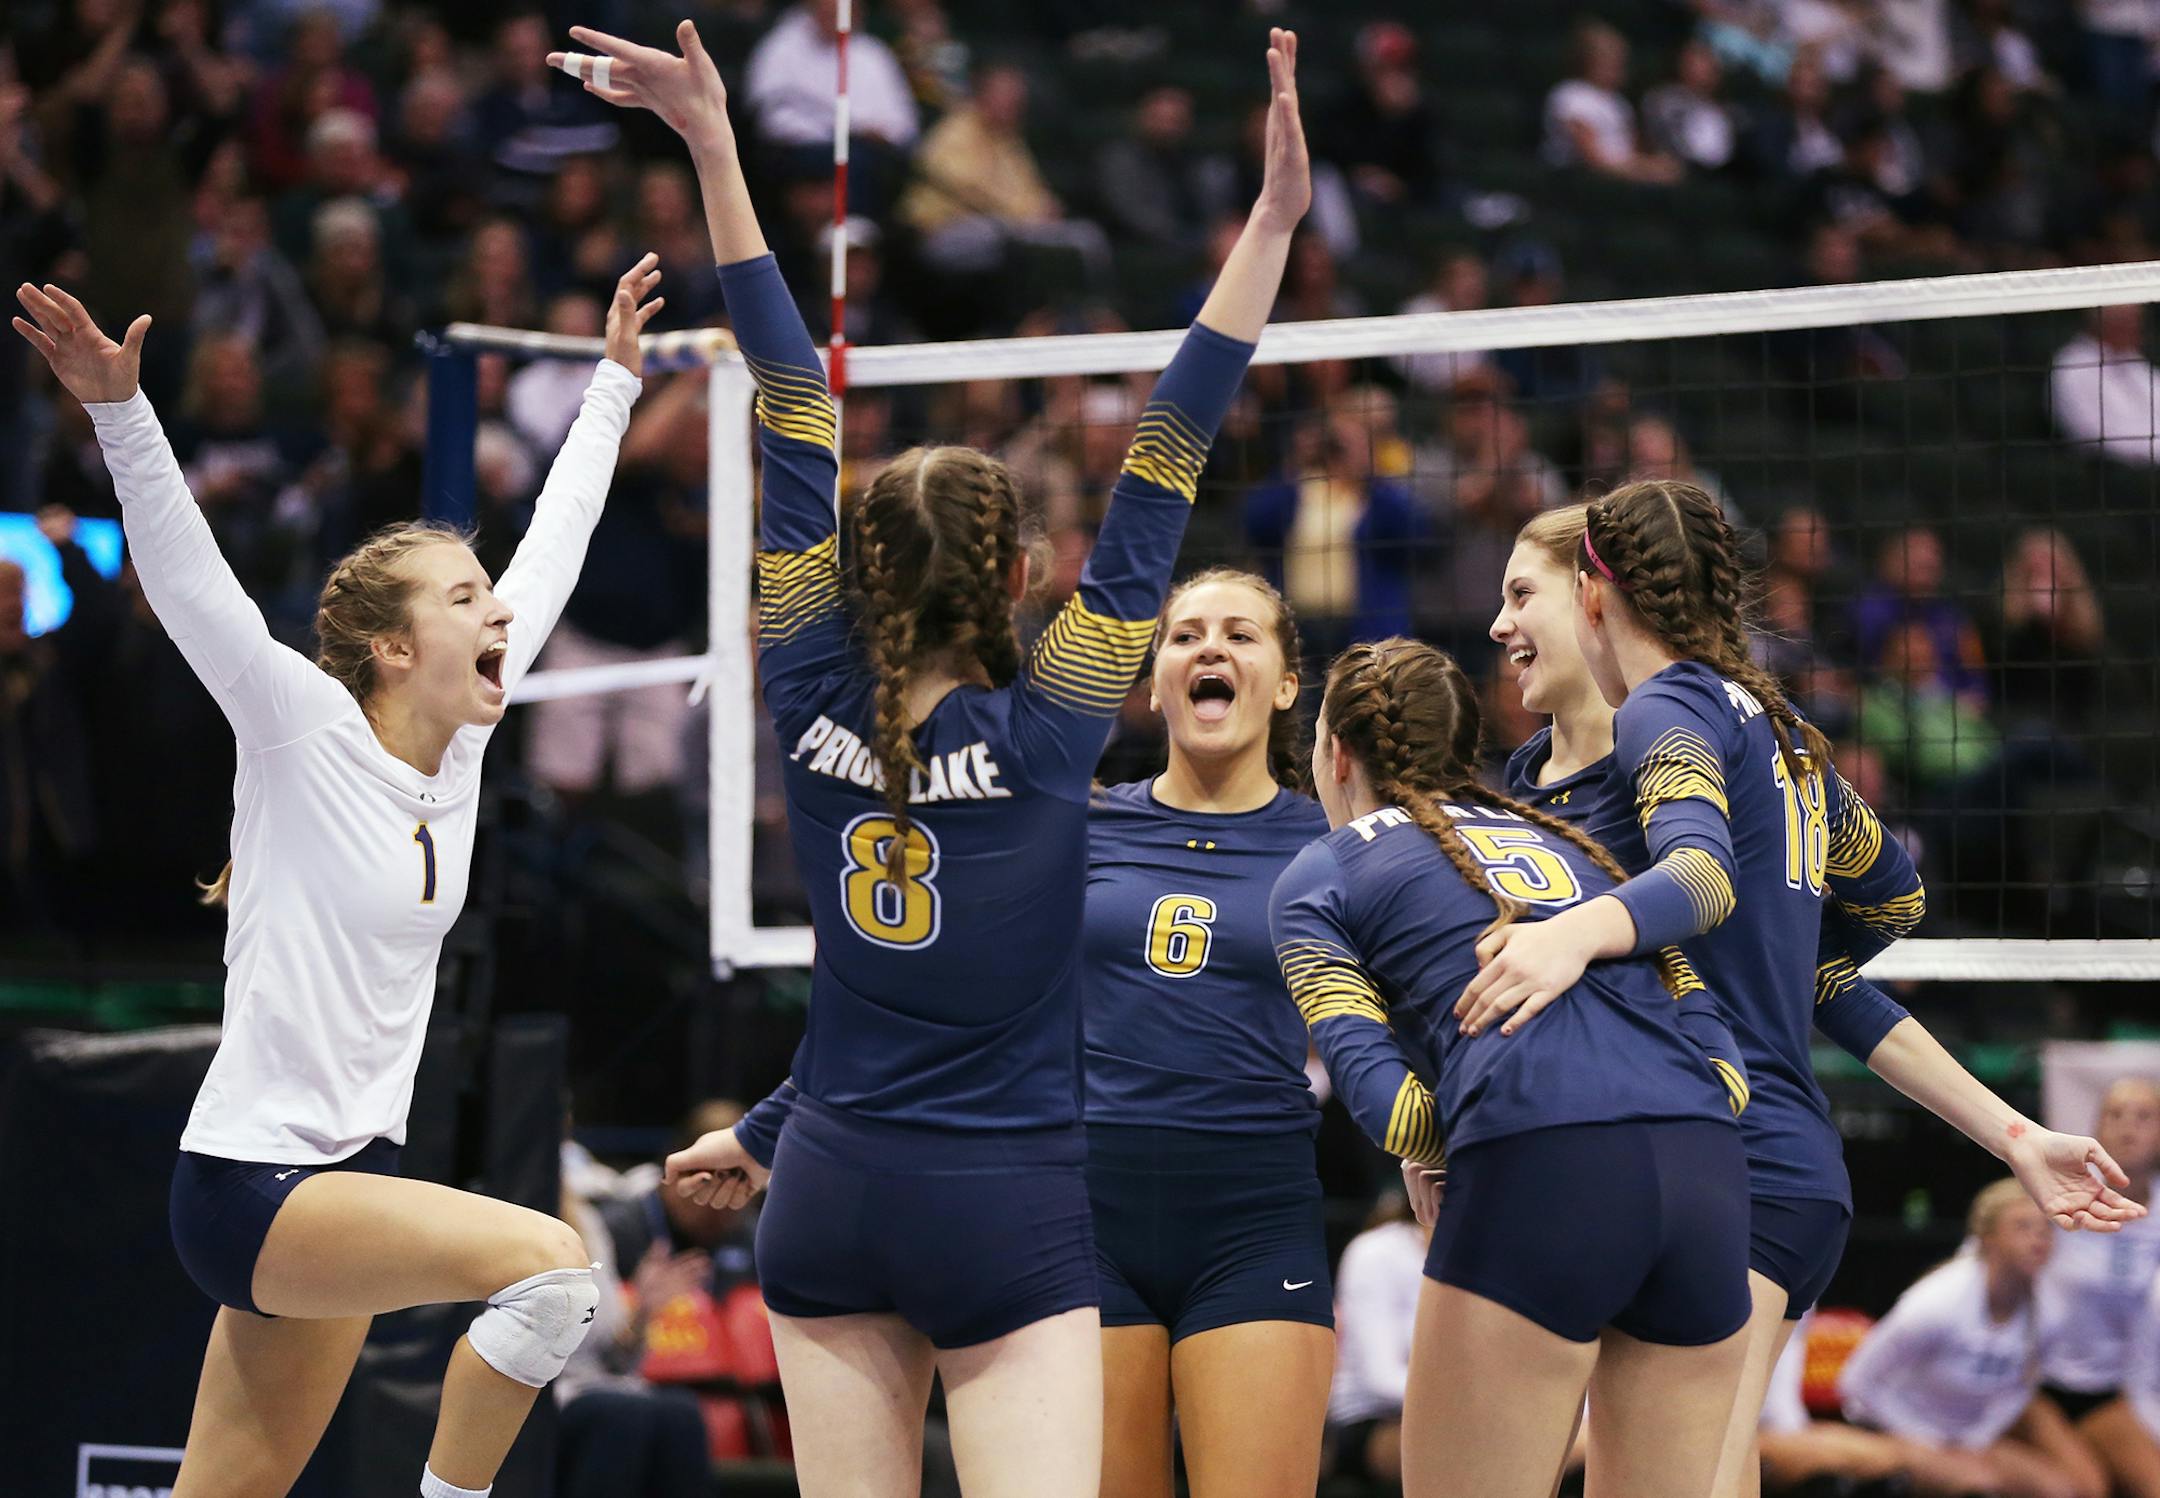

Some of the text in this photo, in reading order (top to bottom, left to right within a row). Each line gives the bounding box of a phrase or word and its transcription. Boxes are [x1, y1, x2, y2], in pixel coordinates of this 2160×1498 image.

[908, 741, 1013, 804] LAKE
[1771, 739, 1830, 897] 18
[412, 819, 437, 905] 1
[839, 811, 942, 951] 8
[1454, 825, 1583, 907] 5
[1144, 893, 1218, 979] 6
